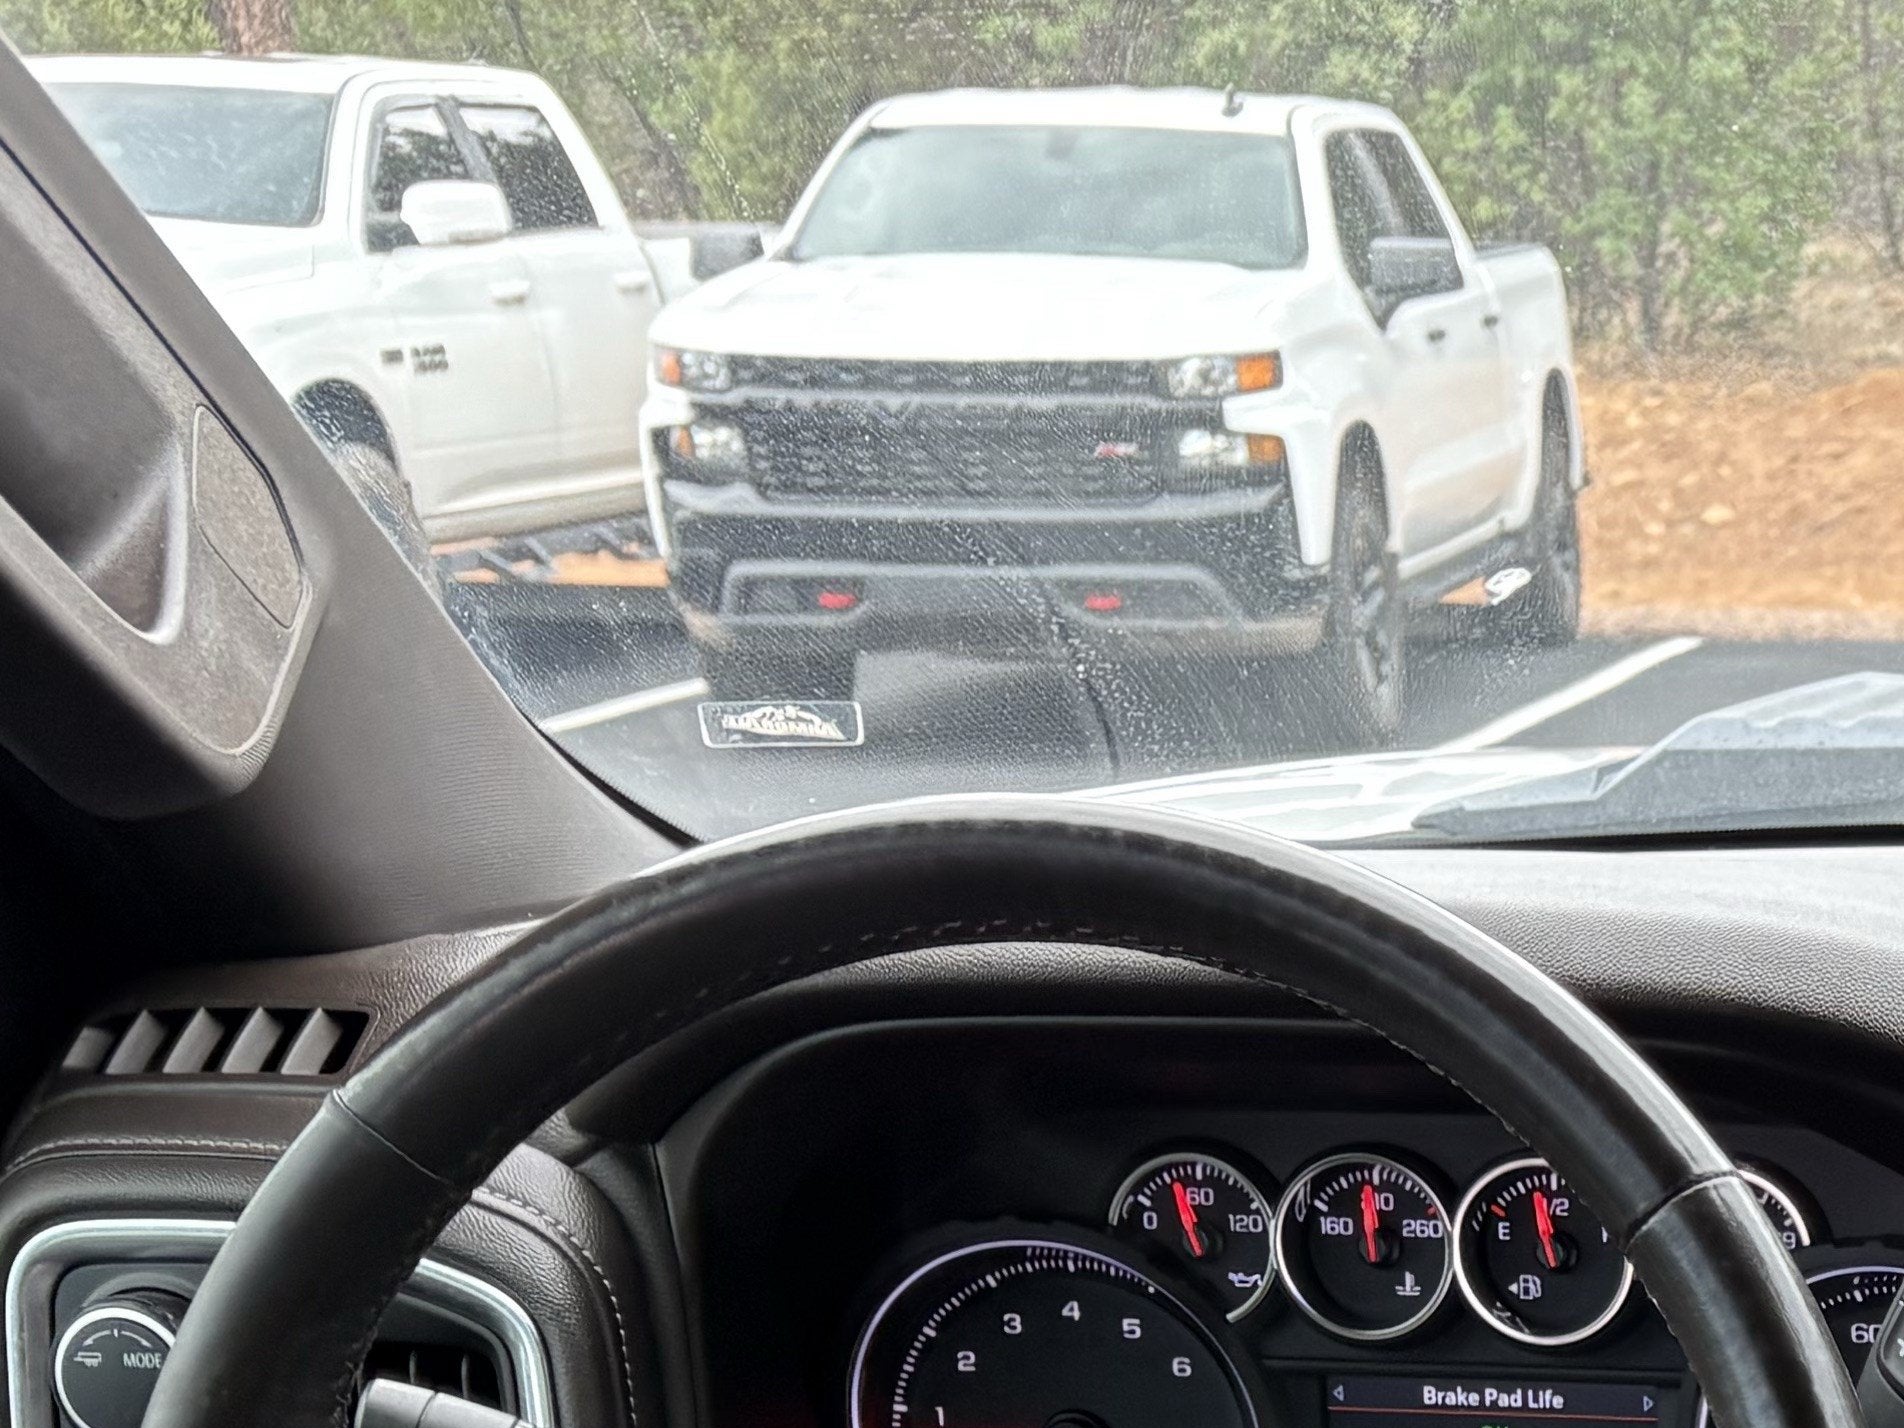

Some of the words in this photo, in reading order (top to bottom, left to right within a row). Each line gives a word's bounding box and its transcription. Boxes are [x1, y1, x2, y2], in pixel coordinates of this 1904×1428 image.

[1142, 1211, 1158, 1231] 0
[1228, 1213, 1263, 1234] 120
[1320, 1217, 1354, 1237] 160
[1402, 1218, 1444, 1239] 260
[1498, 1221, 1511, 1241] E
[1061, 1300, 1081, 1322] 4
[1002, 1312, 1023, 1335] 3
[1121, 1317, 1142, 1340] 5
[122, 1351, 163, 1369] MODE
[956, 1350, 976, 1373] 2
[1171, 1356, 1192, 1378] 6
[1422, 1384, 1480, 1407] Brake
[1484, 1387, 1523, 1408] Pad
[1527, 1389, 1565, 1410] Life
[934, 1406, 945, 1428] 1
